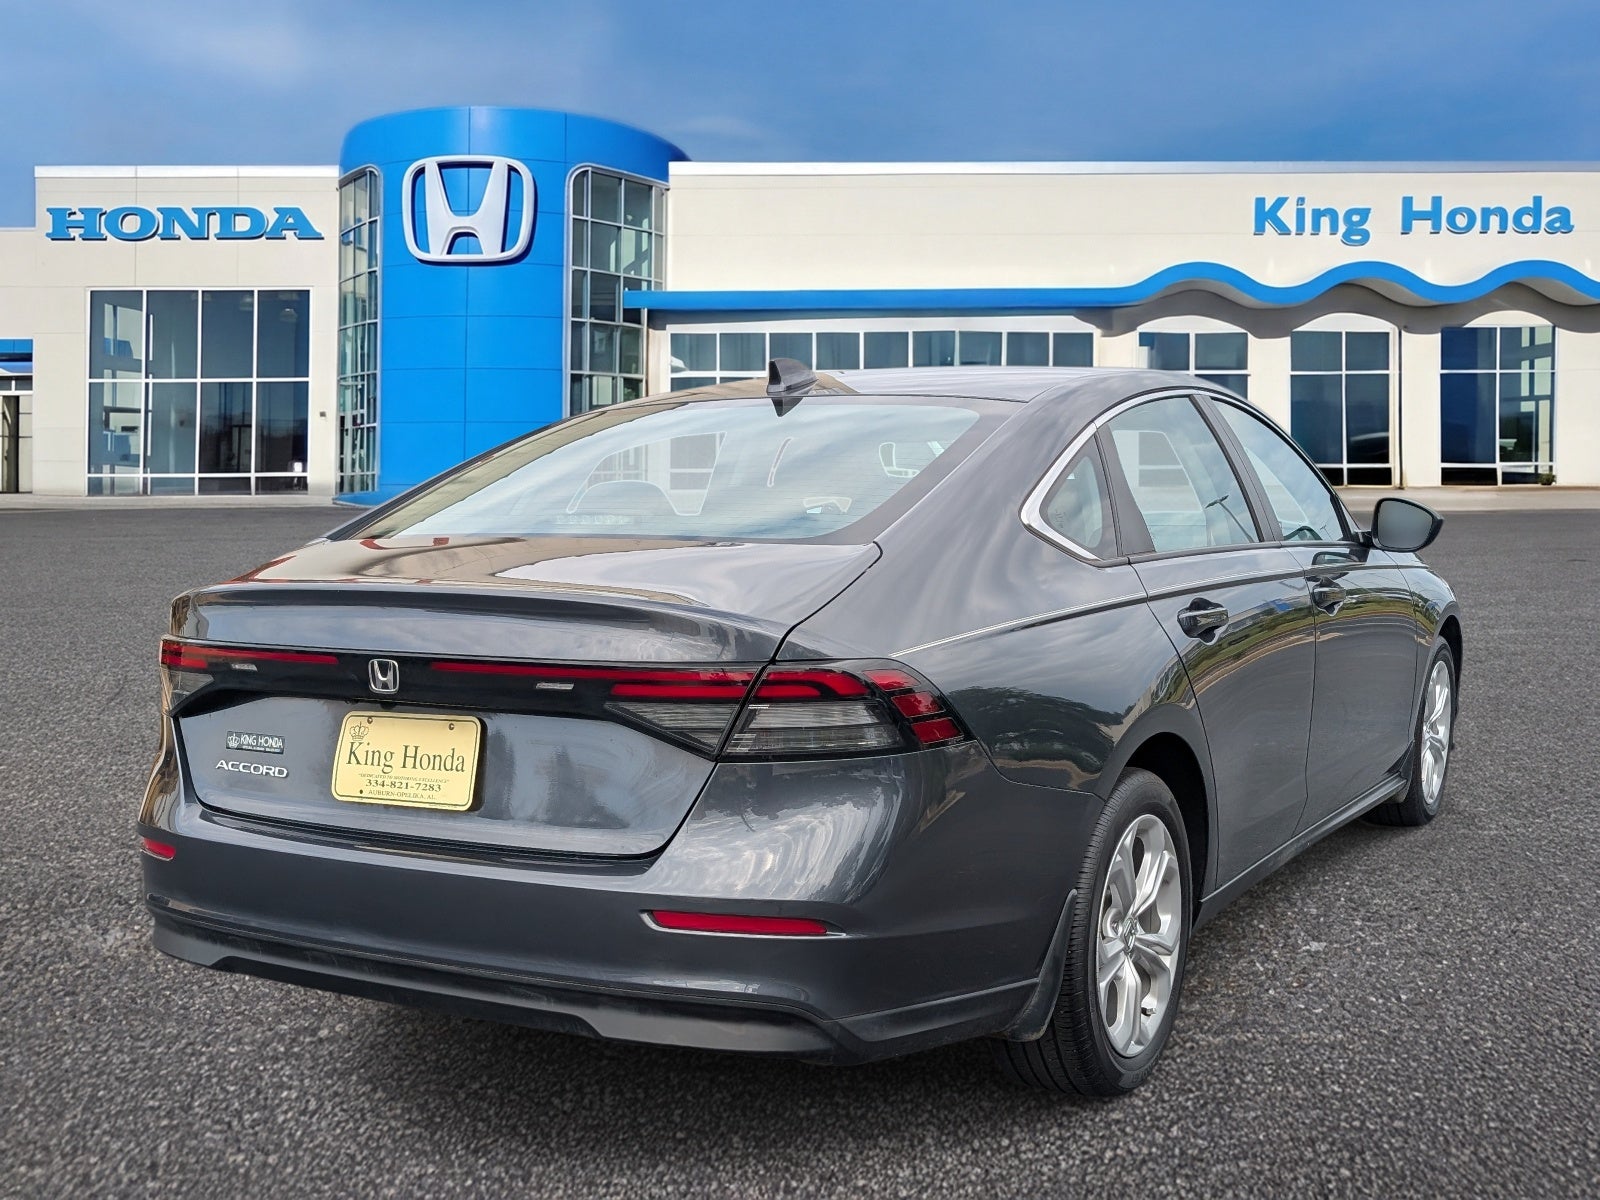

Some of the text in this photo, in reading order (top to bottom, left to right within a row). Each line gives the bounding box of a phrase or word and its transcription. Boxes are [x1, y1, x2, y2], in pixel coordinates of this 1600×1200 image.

[45, 206, 325, 241] HONDA
[1252, 195, 1575, 247] King Honda
[240, 734, 257, 746] KING
[258, 735, 284, 749] HONDA
[215, 759, 289, 778] ACCORD
[346, 741, 466, 774] King Honda
[365, 779, 442, 792] 334-821-7283
